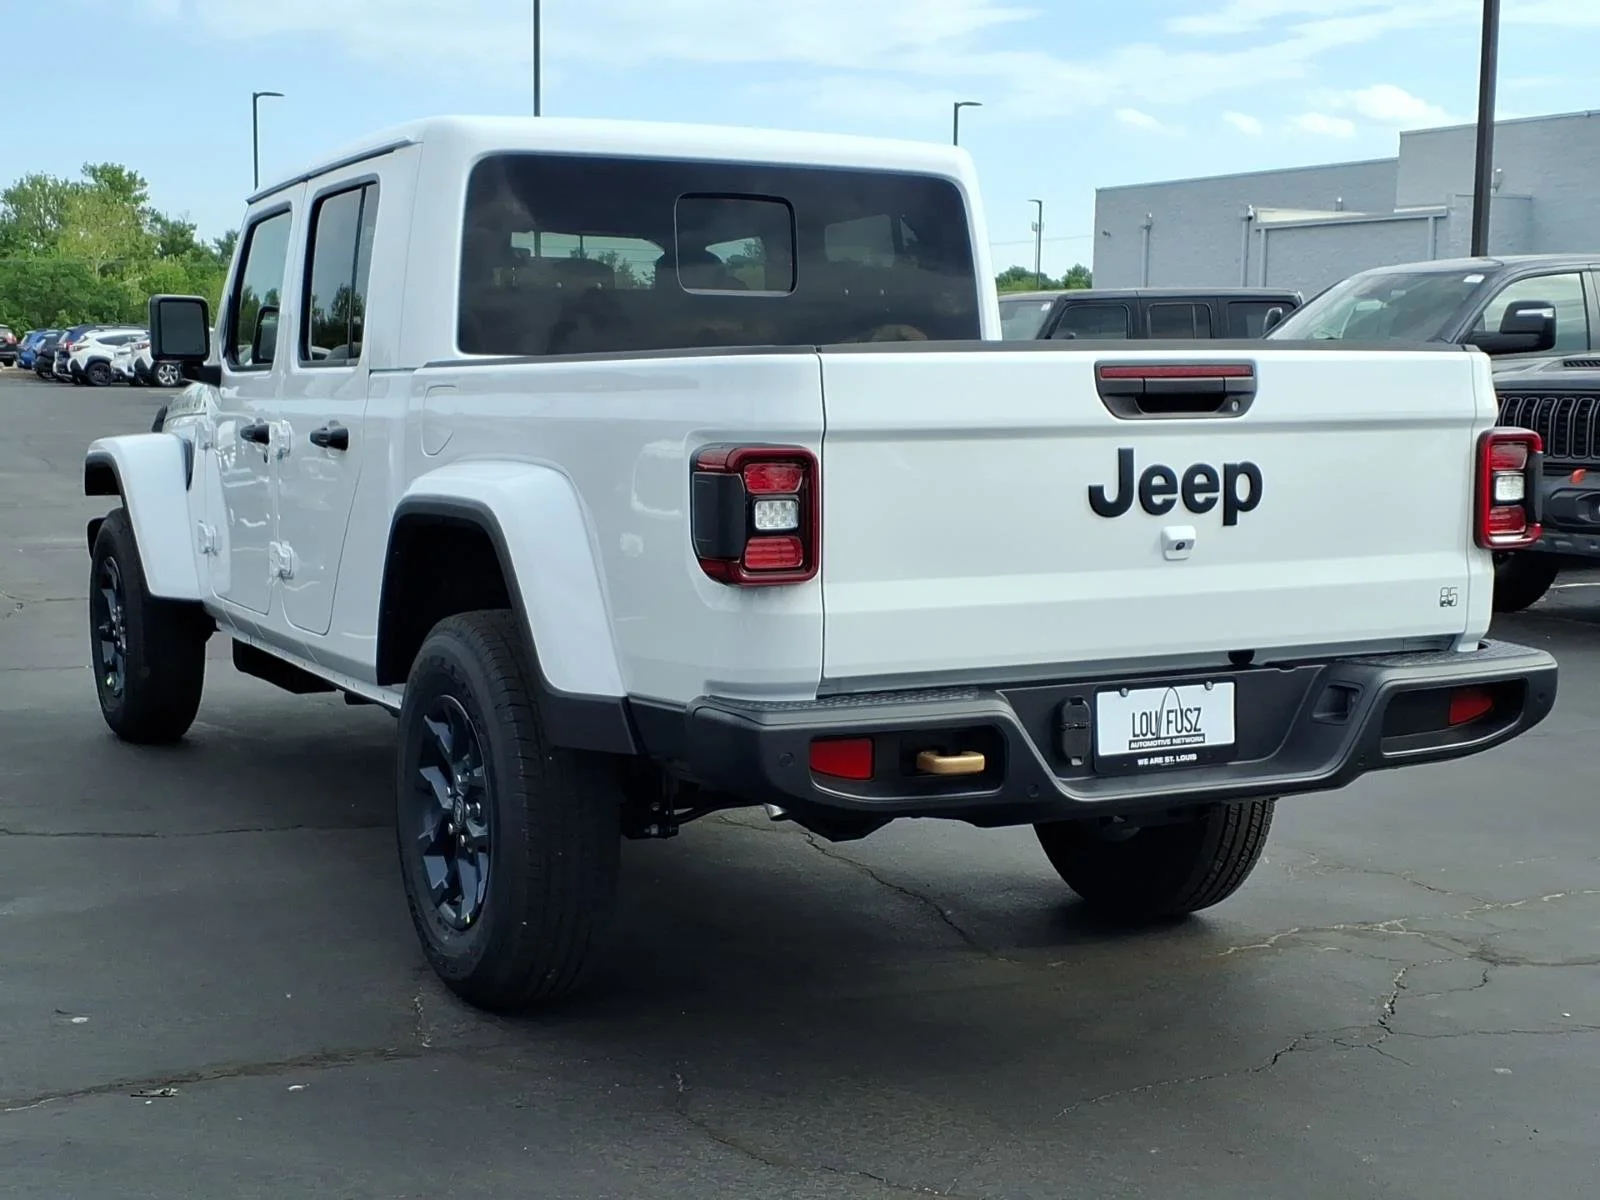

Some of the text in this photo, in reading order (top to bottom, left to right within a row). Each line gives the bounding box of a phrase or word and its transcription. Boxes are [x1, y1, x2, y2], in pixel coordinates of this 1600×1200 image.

[1088, 447, 1263, 526] Jeep
[1132, 707, 1201, 738] LOU FUSZ
[1130, 736, 1204, 748] AUTOMOTIVE NETWORK
[1137, 753, 1197, 766] WE ARE ST. LOUIS
